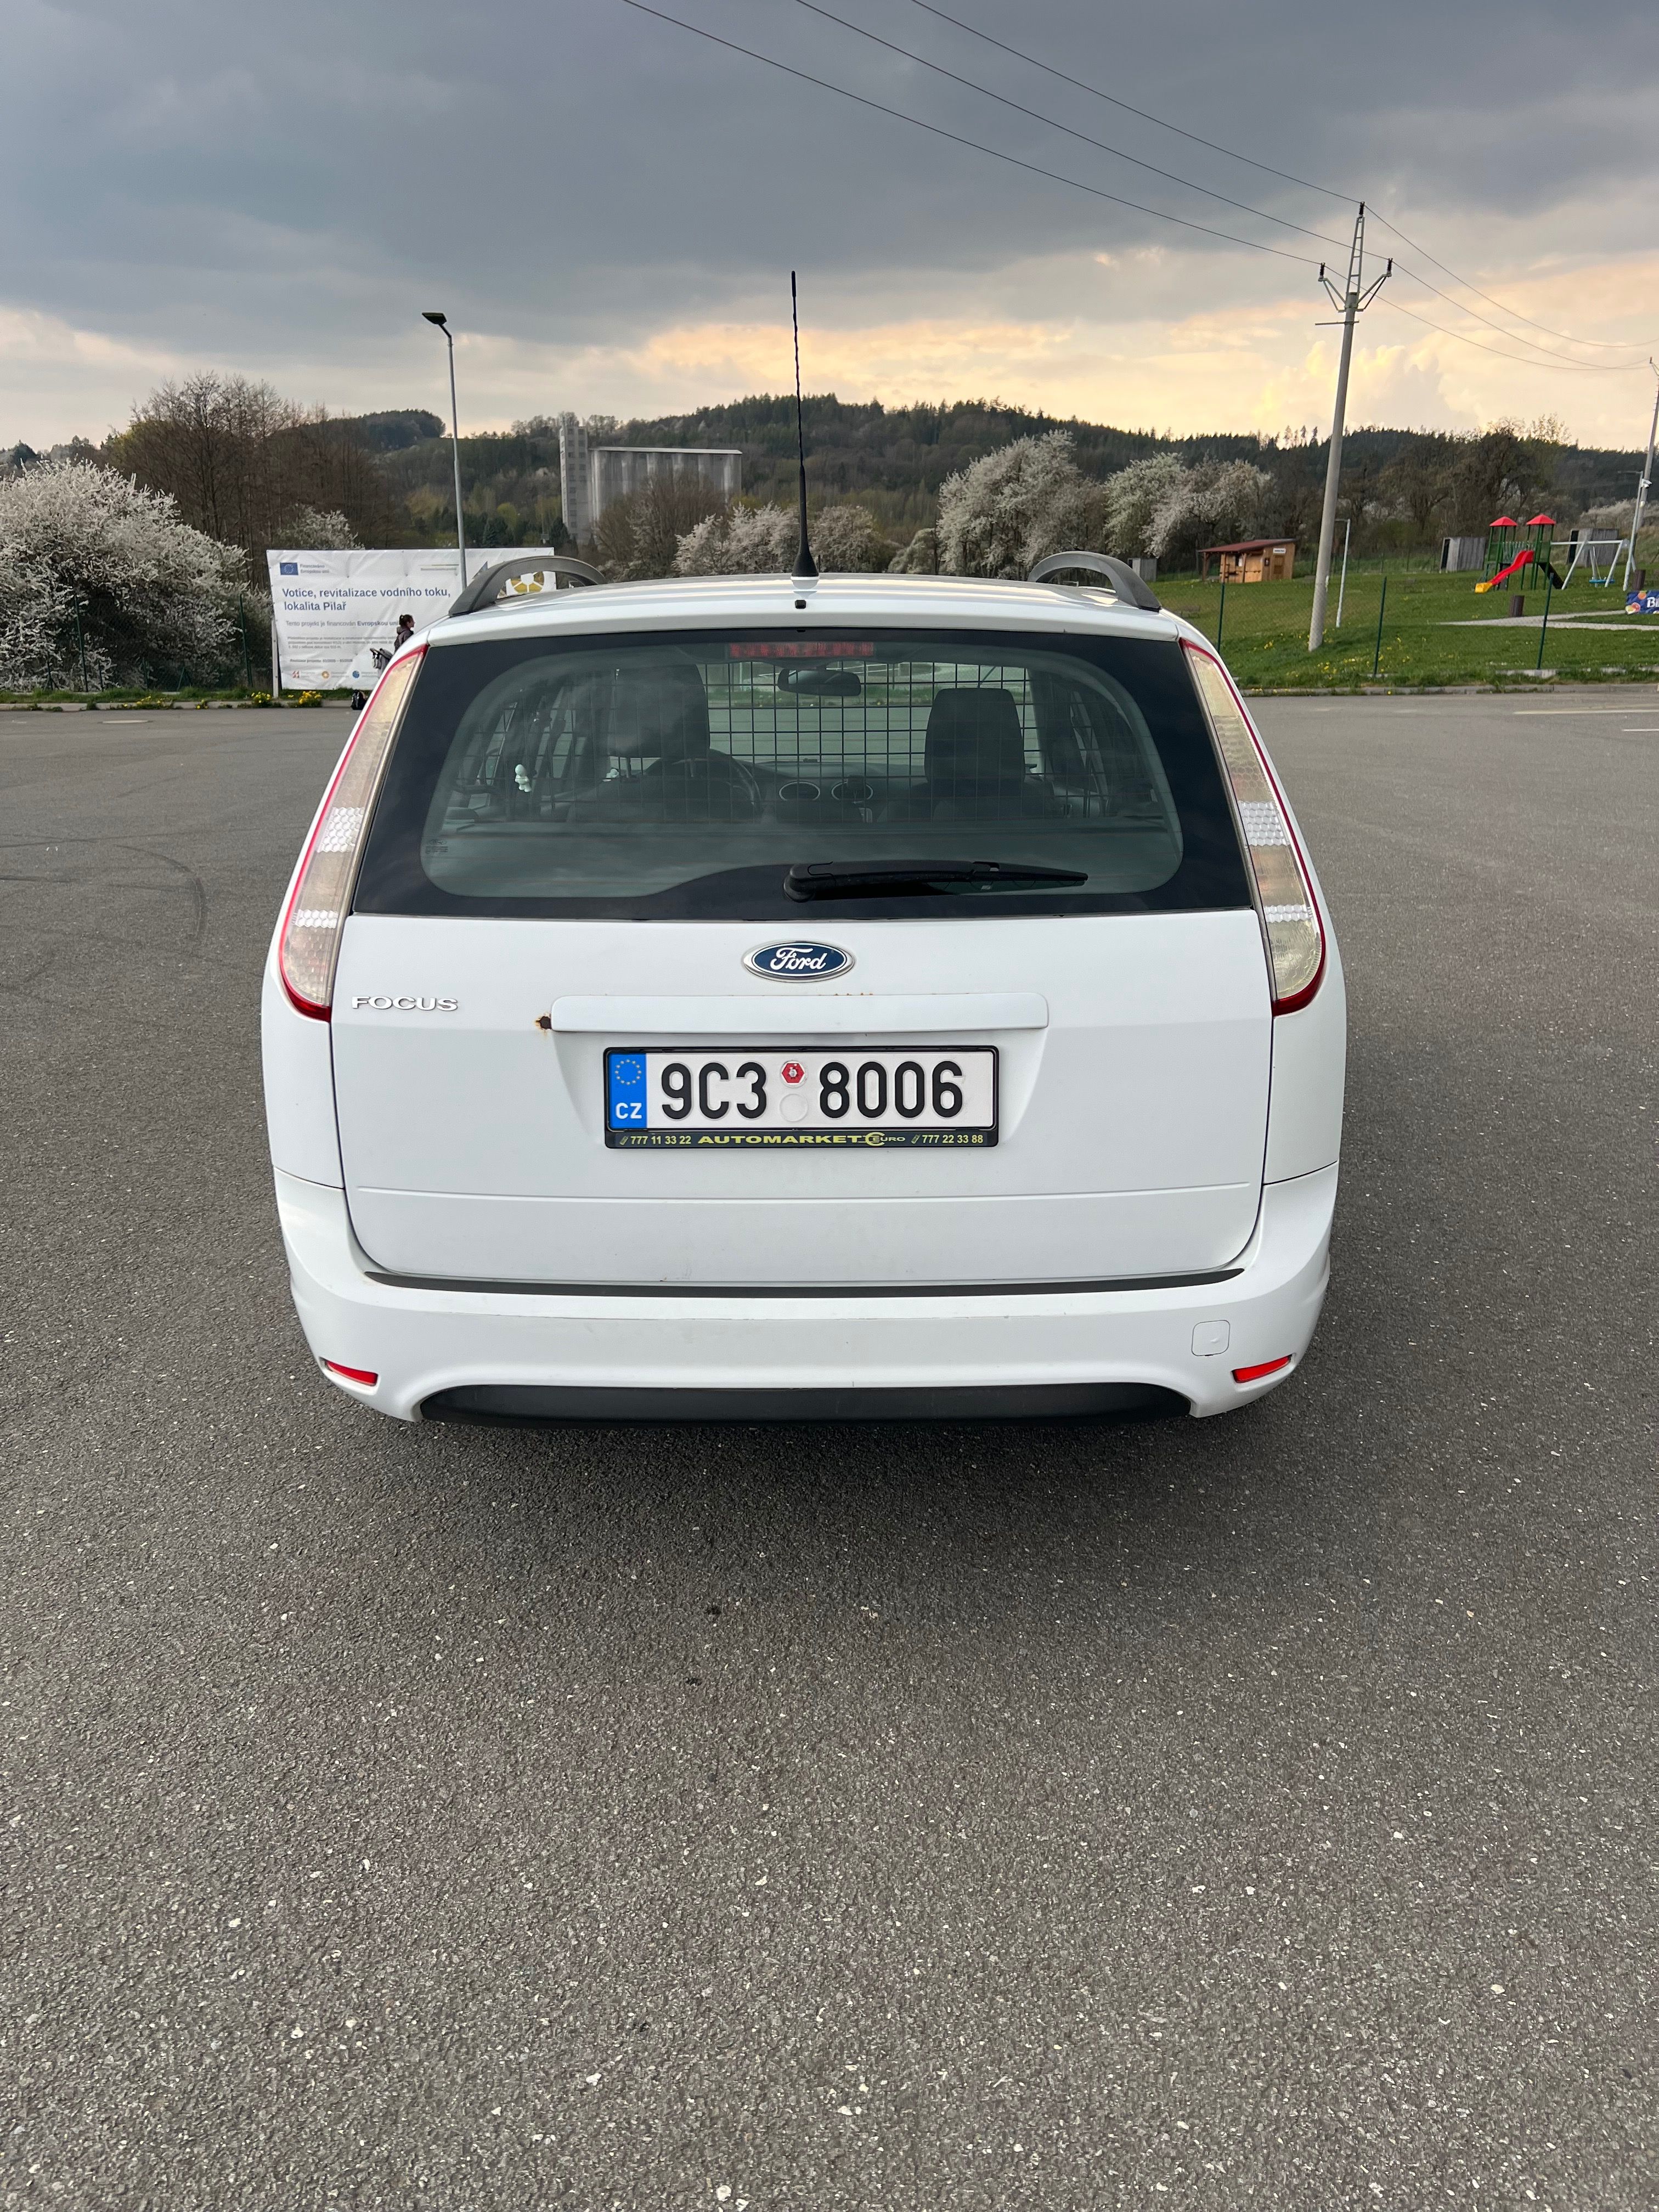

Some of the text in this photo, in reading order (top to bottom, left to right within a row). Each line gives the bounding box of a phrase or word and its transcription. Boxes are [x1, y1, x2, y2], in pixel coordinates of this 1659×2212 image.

[282, 587, 451, 599] Votice, revitalizace vodního toku,
[284, 601, 347, 611] lokalita Pilař
[770, 947, 827, 970] Ford
[351, 996, 458, 1011] FOCUS
[661, 1061, 962, 1119] 9C3 8006
[615, 1102, 642, 1119] CZ
[631, 1136, 648, 1144] 777
[651, 1136, 661, 1144] 11
[665, 1136, 677, 1144] 33
[679, 1136, 691, 1144] 22
[698, 1135, 862, 1143] AUTOMARKET
[922, 1135, 940, 1143] 777
[943, 1135, 954, 1143] 22
[957, 1135, 969, 1143] 33
[972, 1135, 983, 1143] 88
